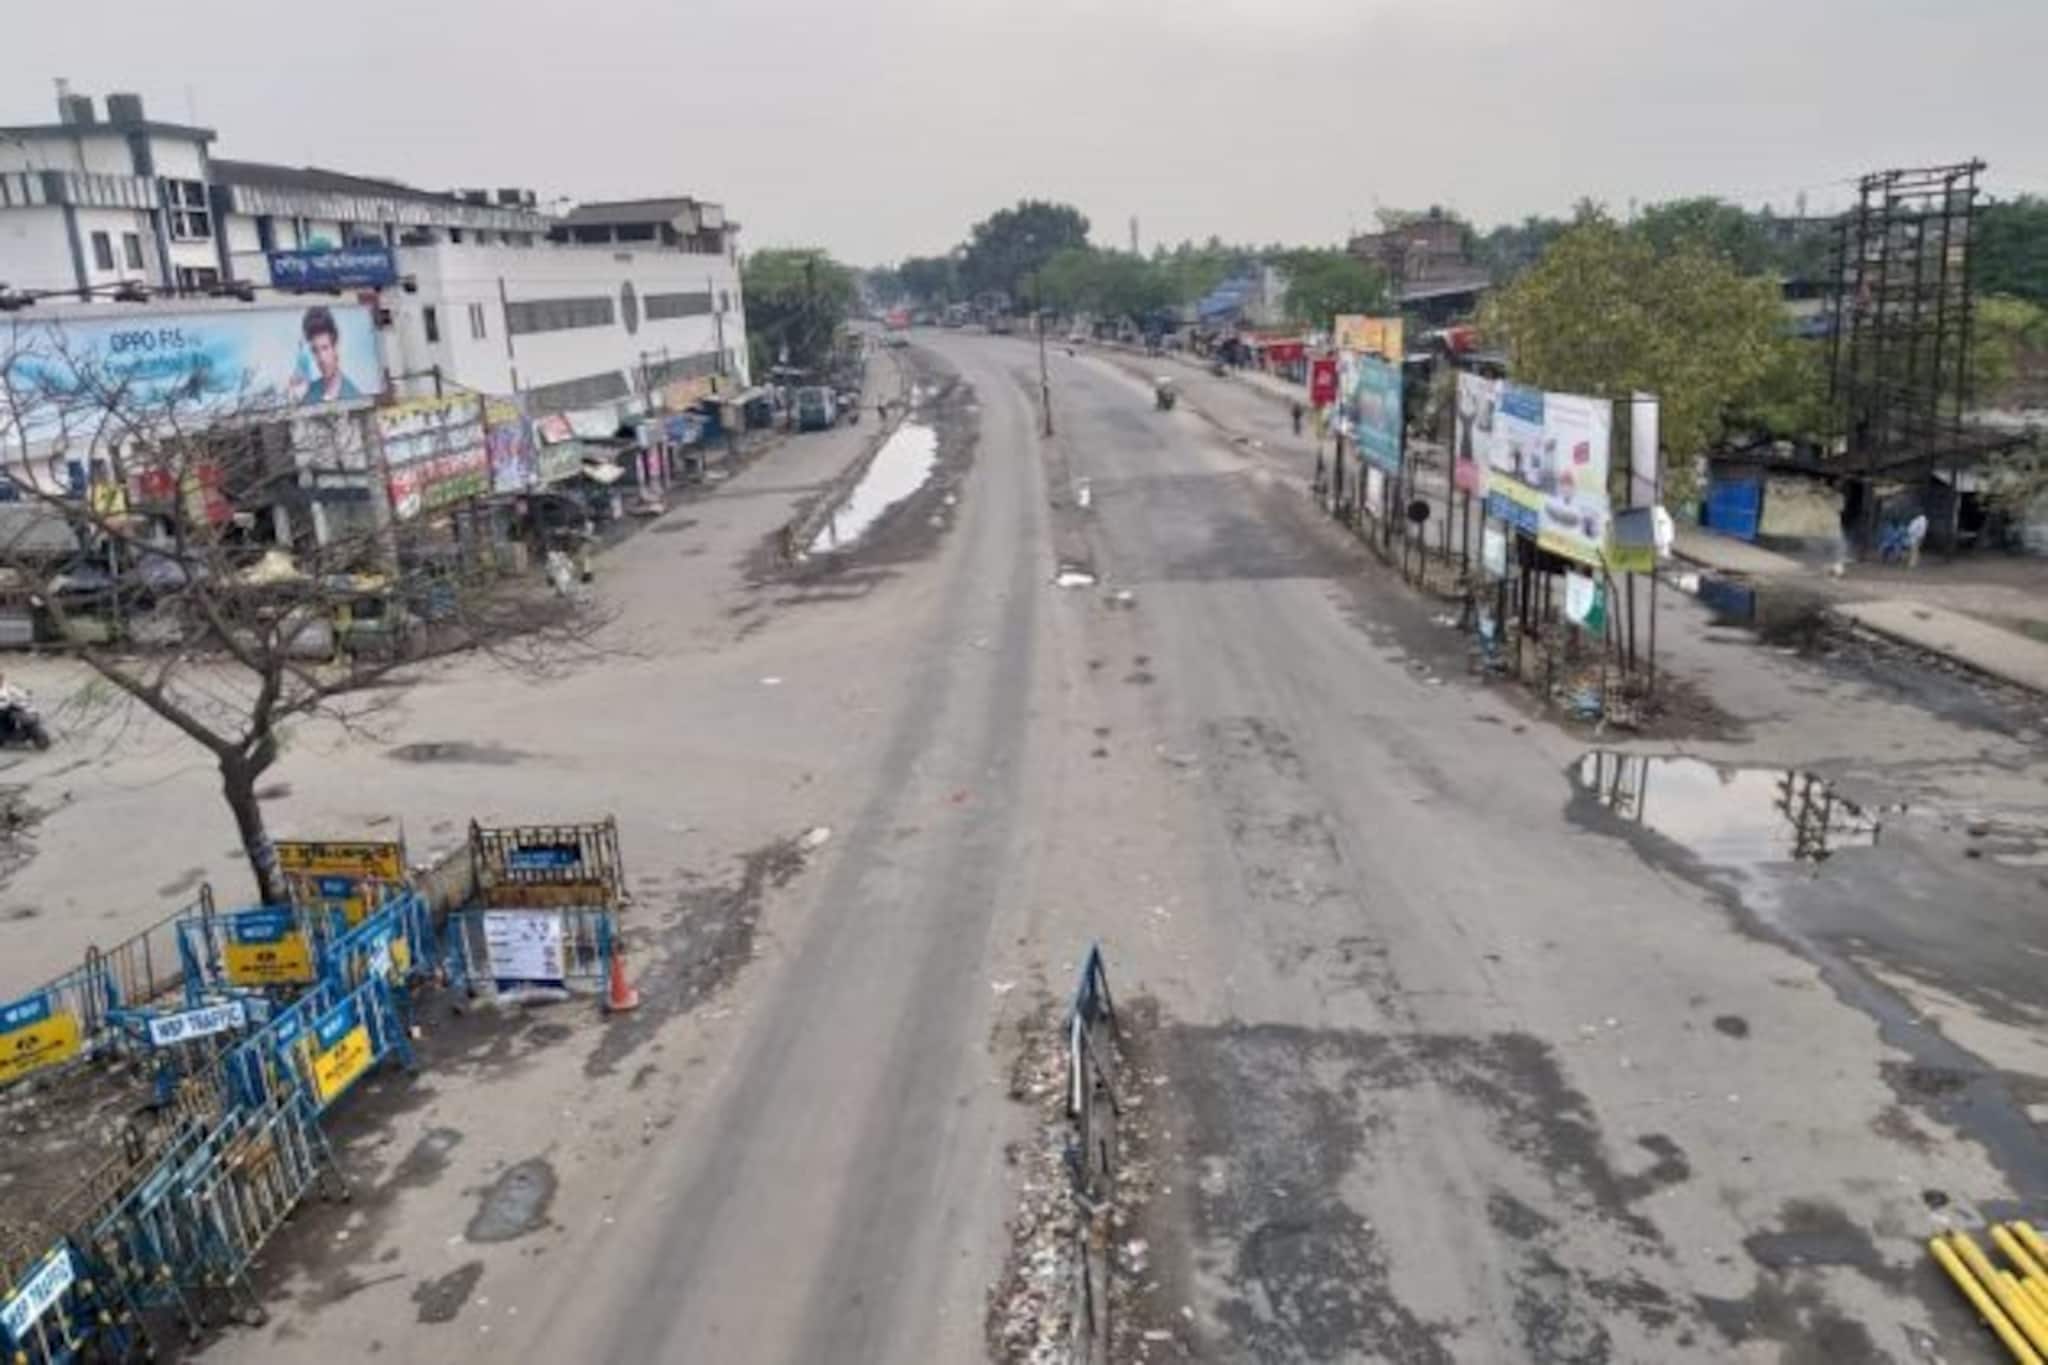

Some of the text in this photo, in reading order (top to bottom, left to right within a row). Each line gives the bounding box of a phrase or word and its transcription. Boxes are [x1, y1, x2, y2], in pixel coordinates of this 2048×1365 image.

[110, 330, 156, 352] OPPO
[158, 328, 185, 350] F15
[187, 1005, 242, 1032] TRAFFIC
[28, 1257, 70, 1301] TRAFFIC
